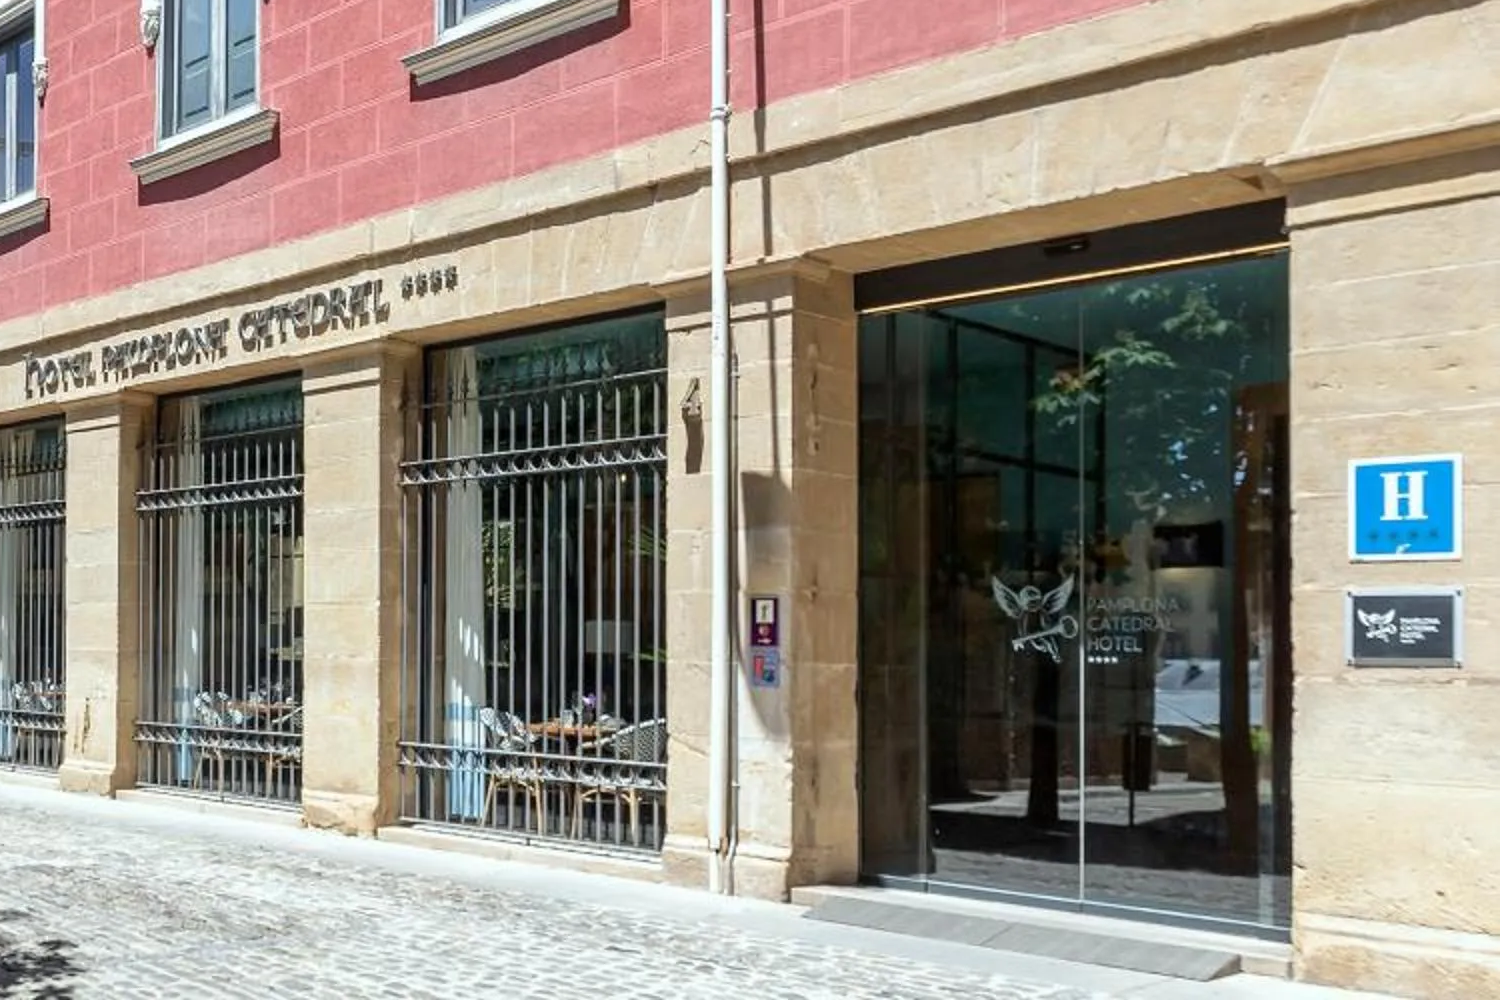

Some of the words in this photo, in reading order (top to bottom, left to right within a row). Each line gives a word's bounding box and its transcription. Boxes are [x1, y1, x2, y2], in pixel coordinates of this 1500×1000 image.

[24, 351, 96, 398] HOTEL
[1379, 470, 1428, 521] H
[1086, 597, 1180, 614] PAMPLONA
[1086, 615, 1176, 632] CATEDRAL
[1086, 635, 1143, 653] HOTEL
